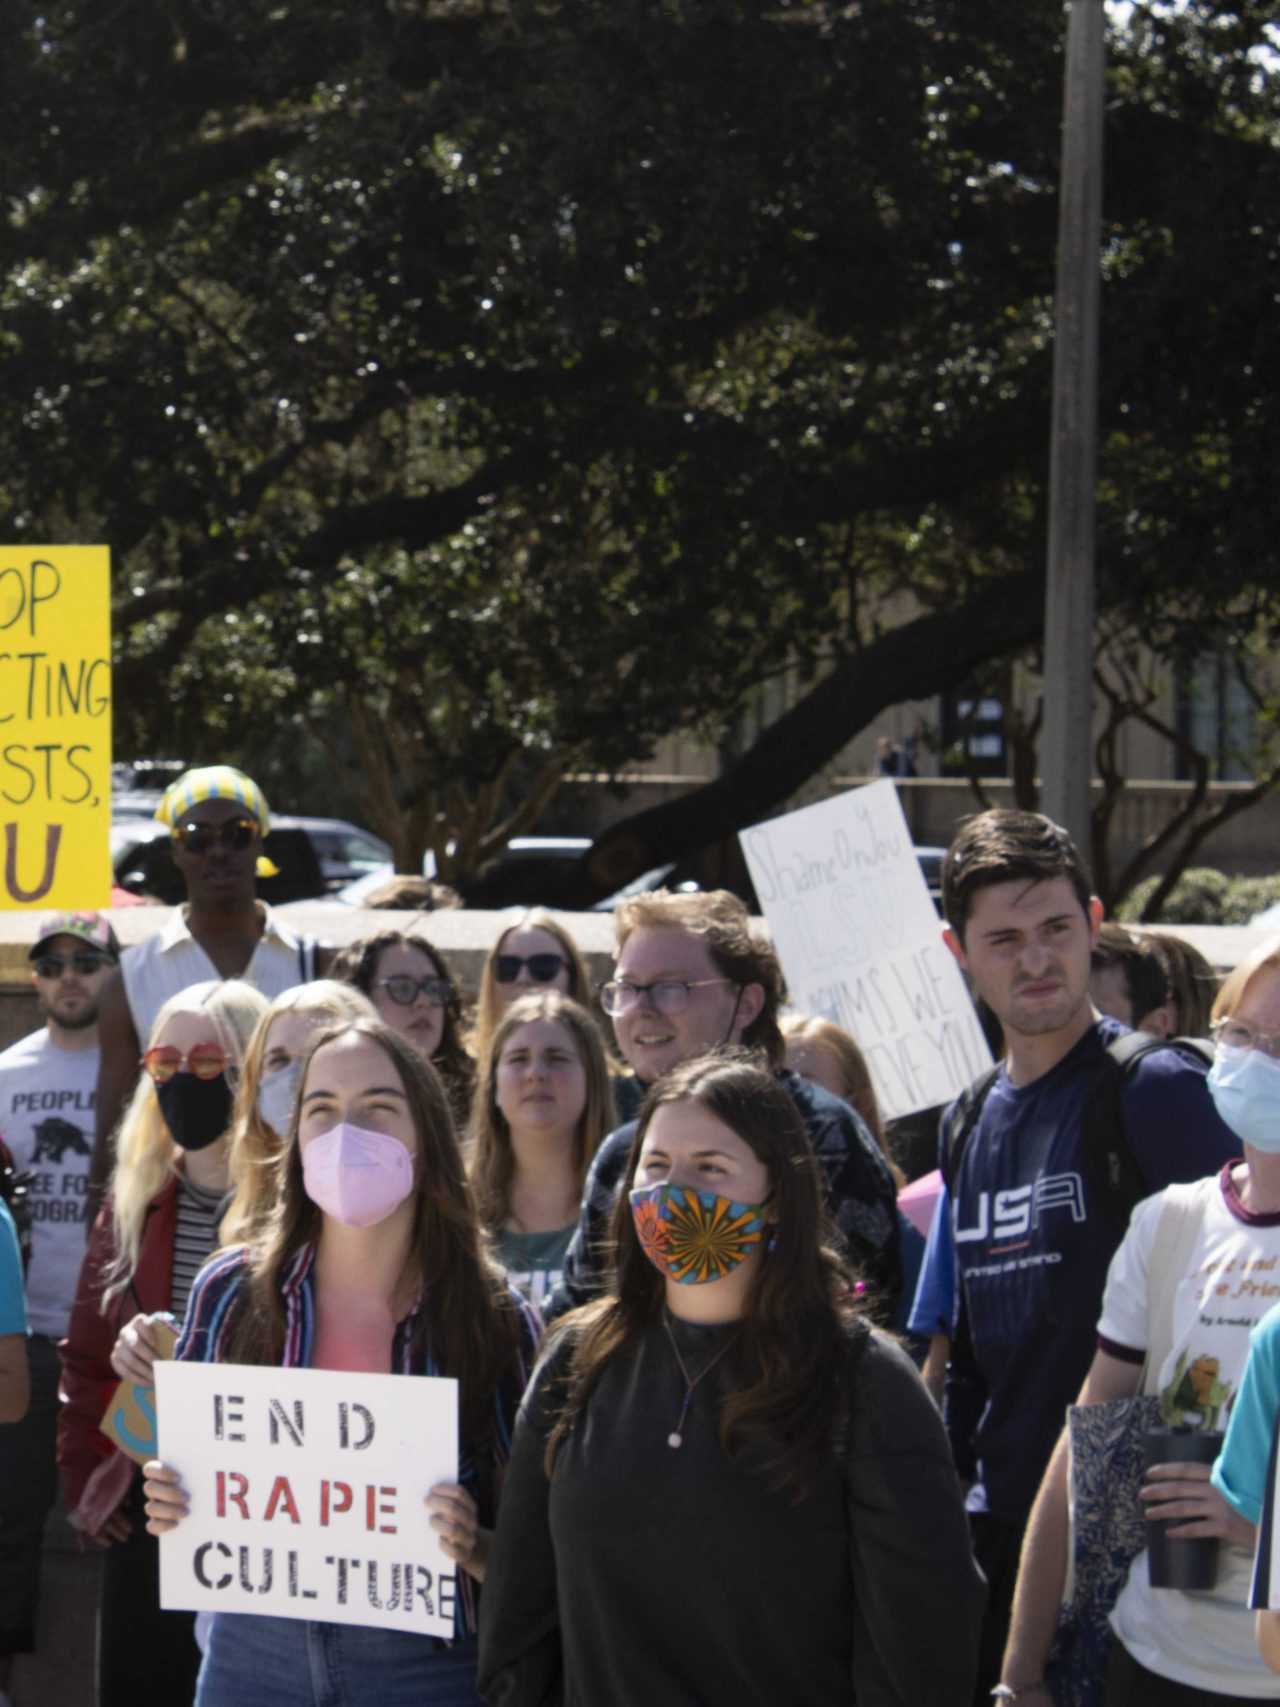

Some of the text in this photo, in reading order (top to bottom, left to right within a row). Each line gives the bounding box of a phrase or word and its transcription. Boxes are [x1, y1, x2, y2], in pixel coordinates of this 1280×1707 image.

[952, 1166, 1087, 1243] USA
[213, 1394, 376, 1451] END
[215, 1470, 399, 1535] RAPE
[193, 1540, 457, 1622] CULTURE
